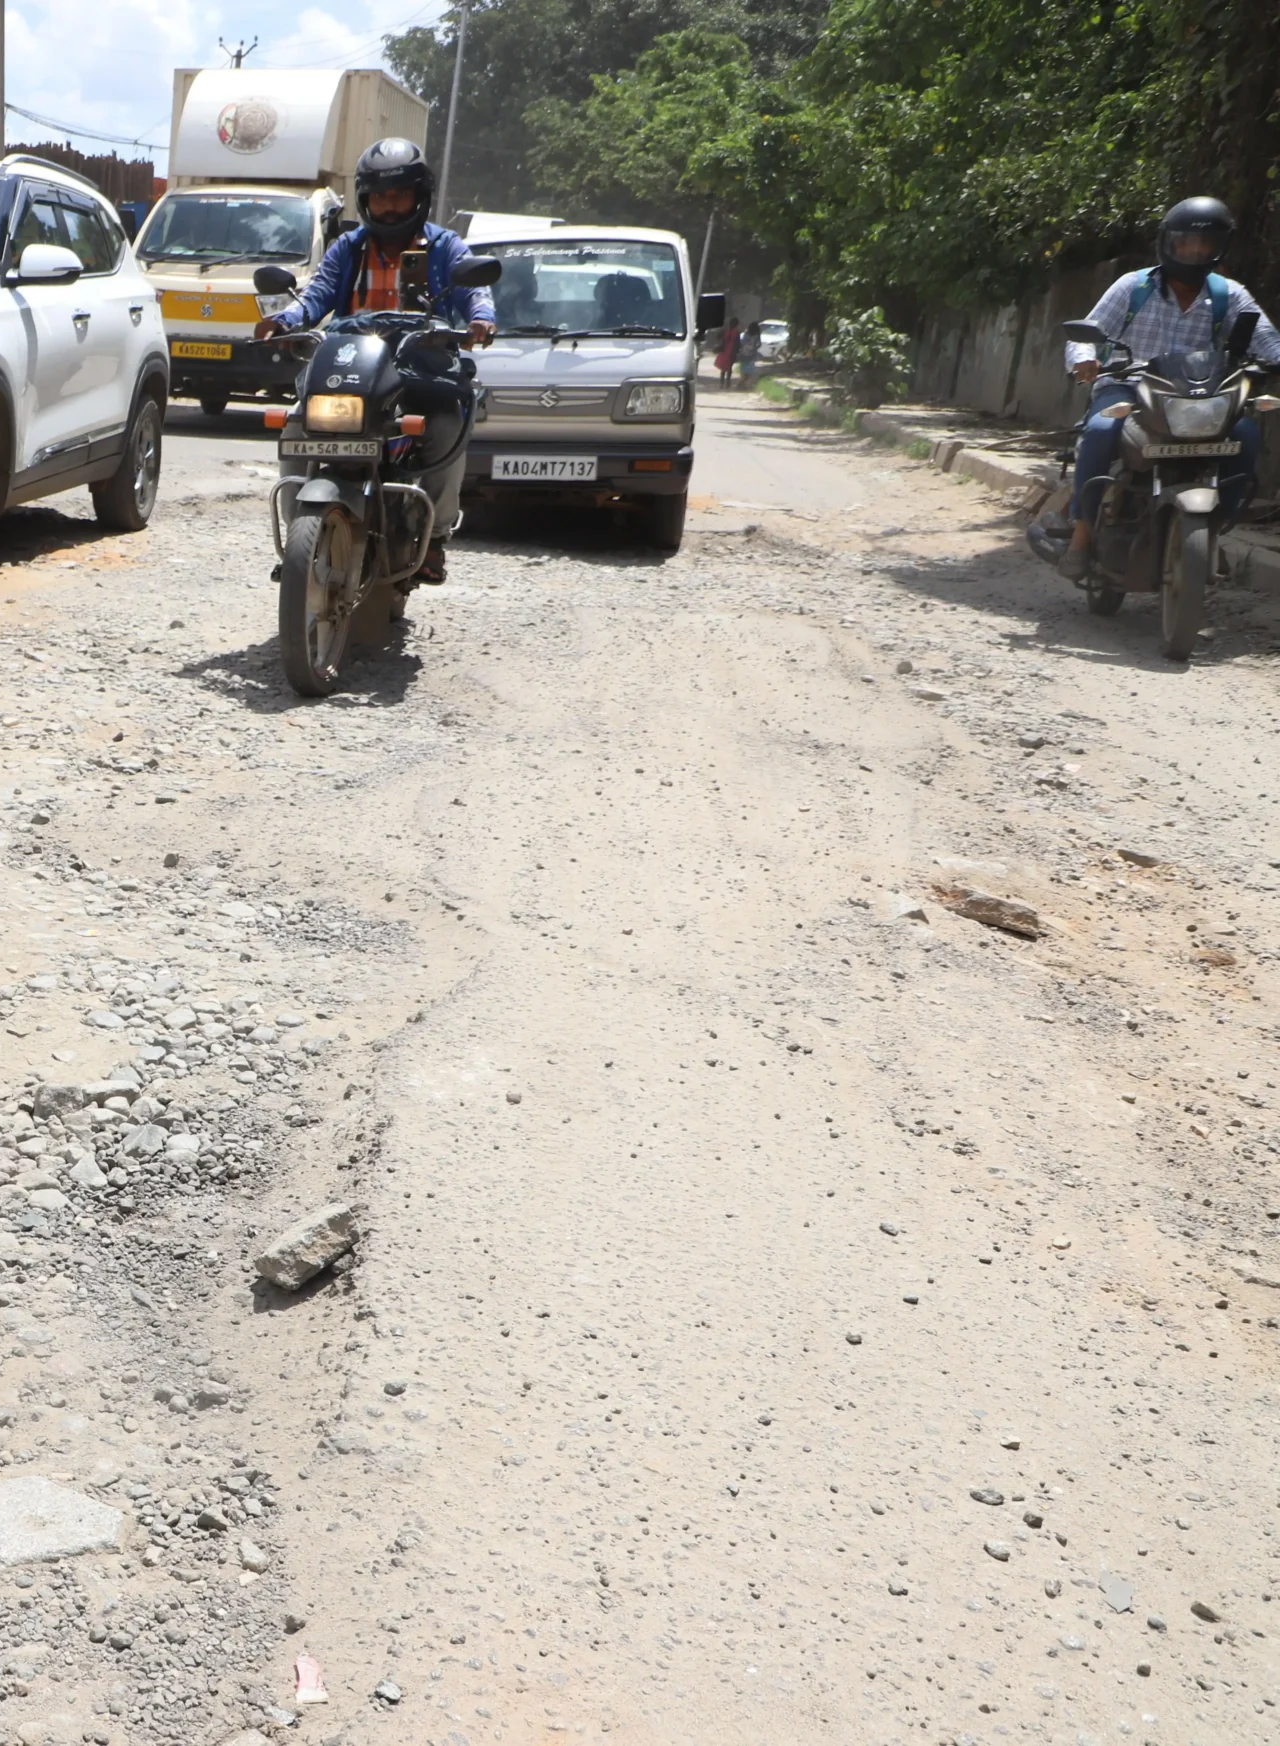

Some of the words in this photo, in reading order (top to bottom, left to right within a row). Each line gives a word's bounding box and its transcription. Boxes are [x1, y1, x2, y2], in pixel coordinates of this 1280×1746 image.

[504, 248, 521, 257] Sri
[523, 247, 579, 257] Subramanya
[582, 245, 626, 255] Prasanna
[293, 443, 307, 454] KA
[317, 443, 338, 454] 54R
[348, 443, 376, 455] 1495
[502, 461, 595, 476] KA04MT7137
